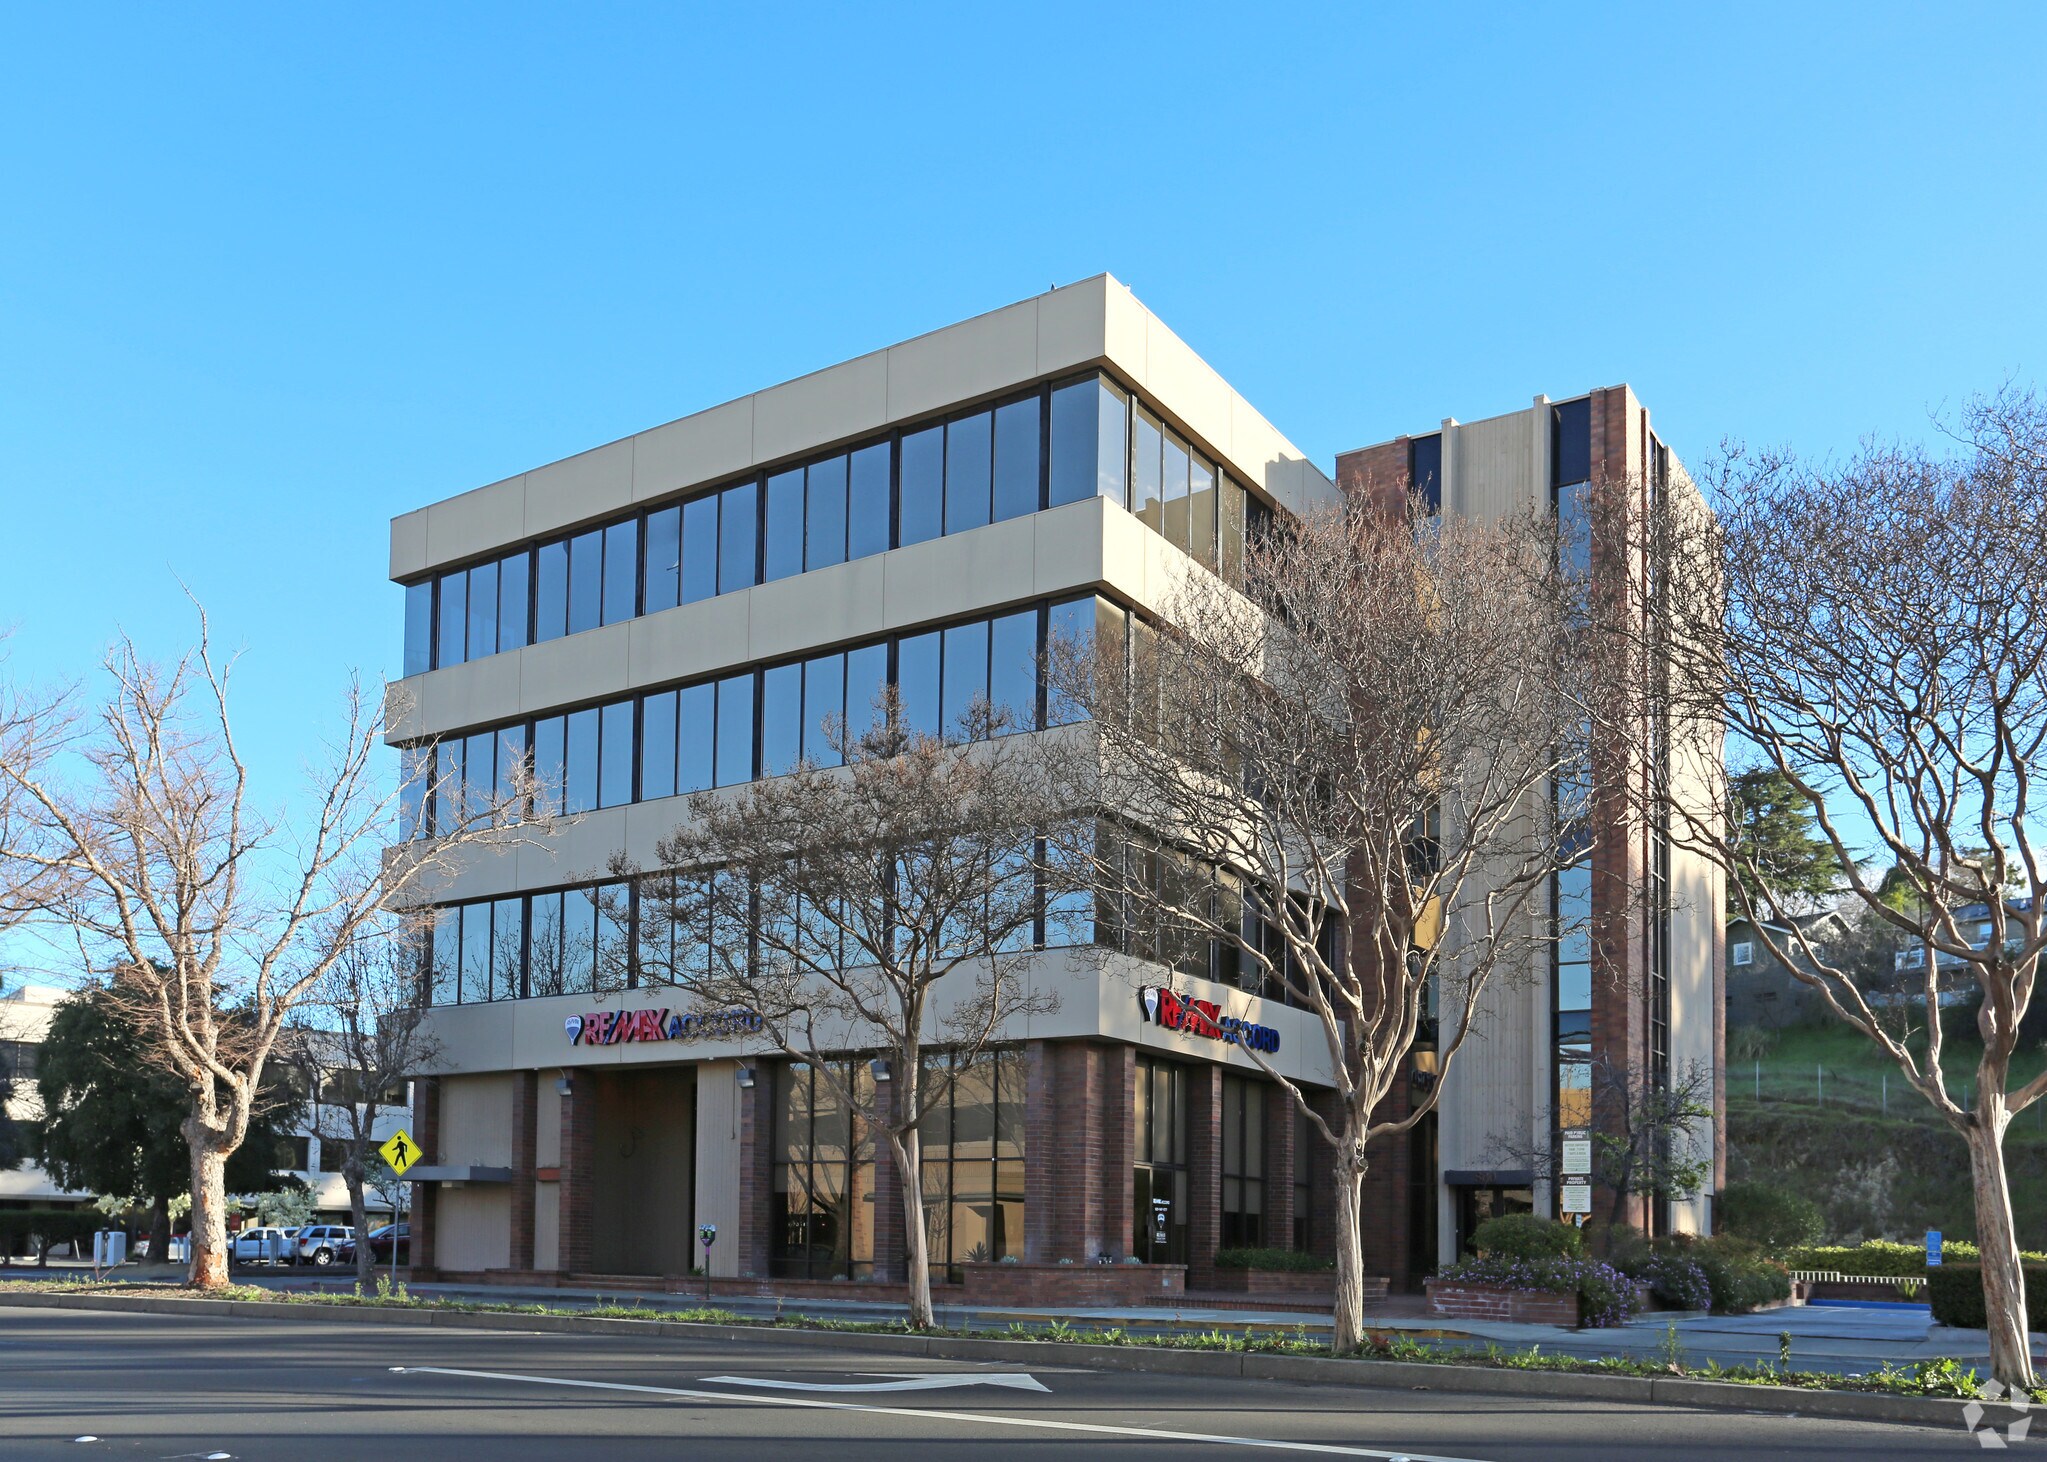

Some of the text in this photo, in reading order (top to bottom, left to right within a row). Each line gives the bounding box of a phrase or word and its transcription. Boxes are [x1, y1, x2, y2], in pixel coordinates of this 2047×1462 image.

[585, 1008, 669, 1045] RE/MAX
[1160, 988, 1281, 1053] RE/MAX ACCORD
